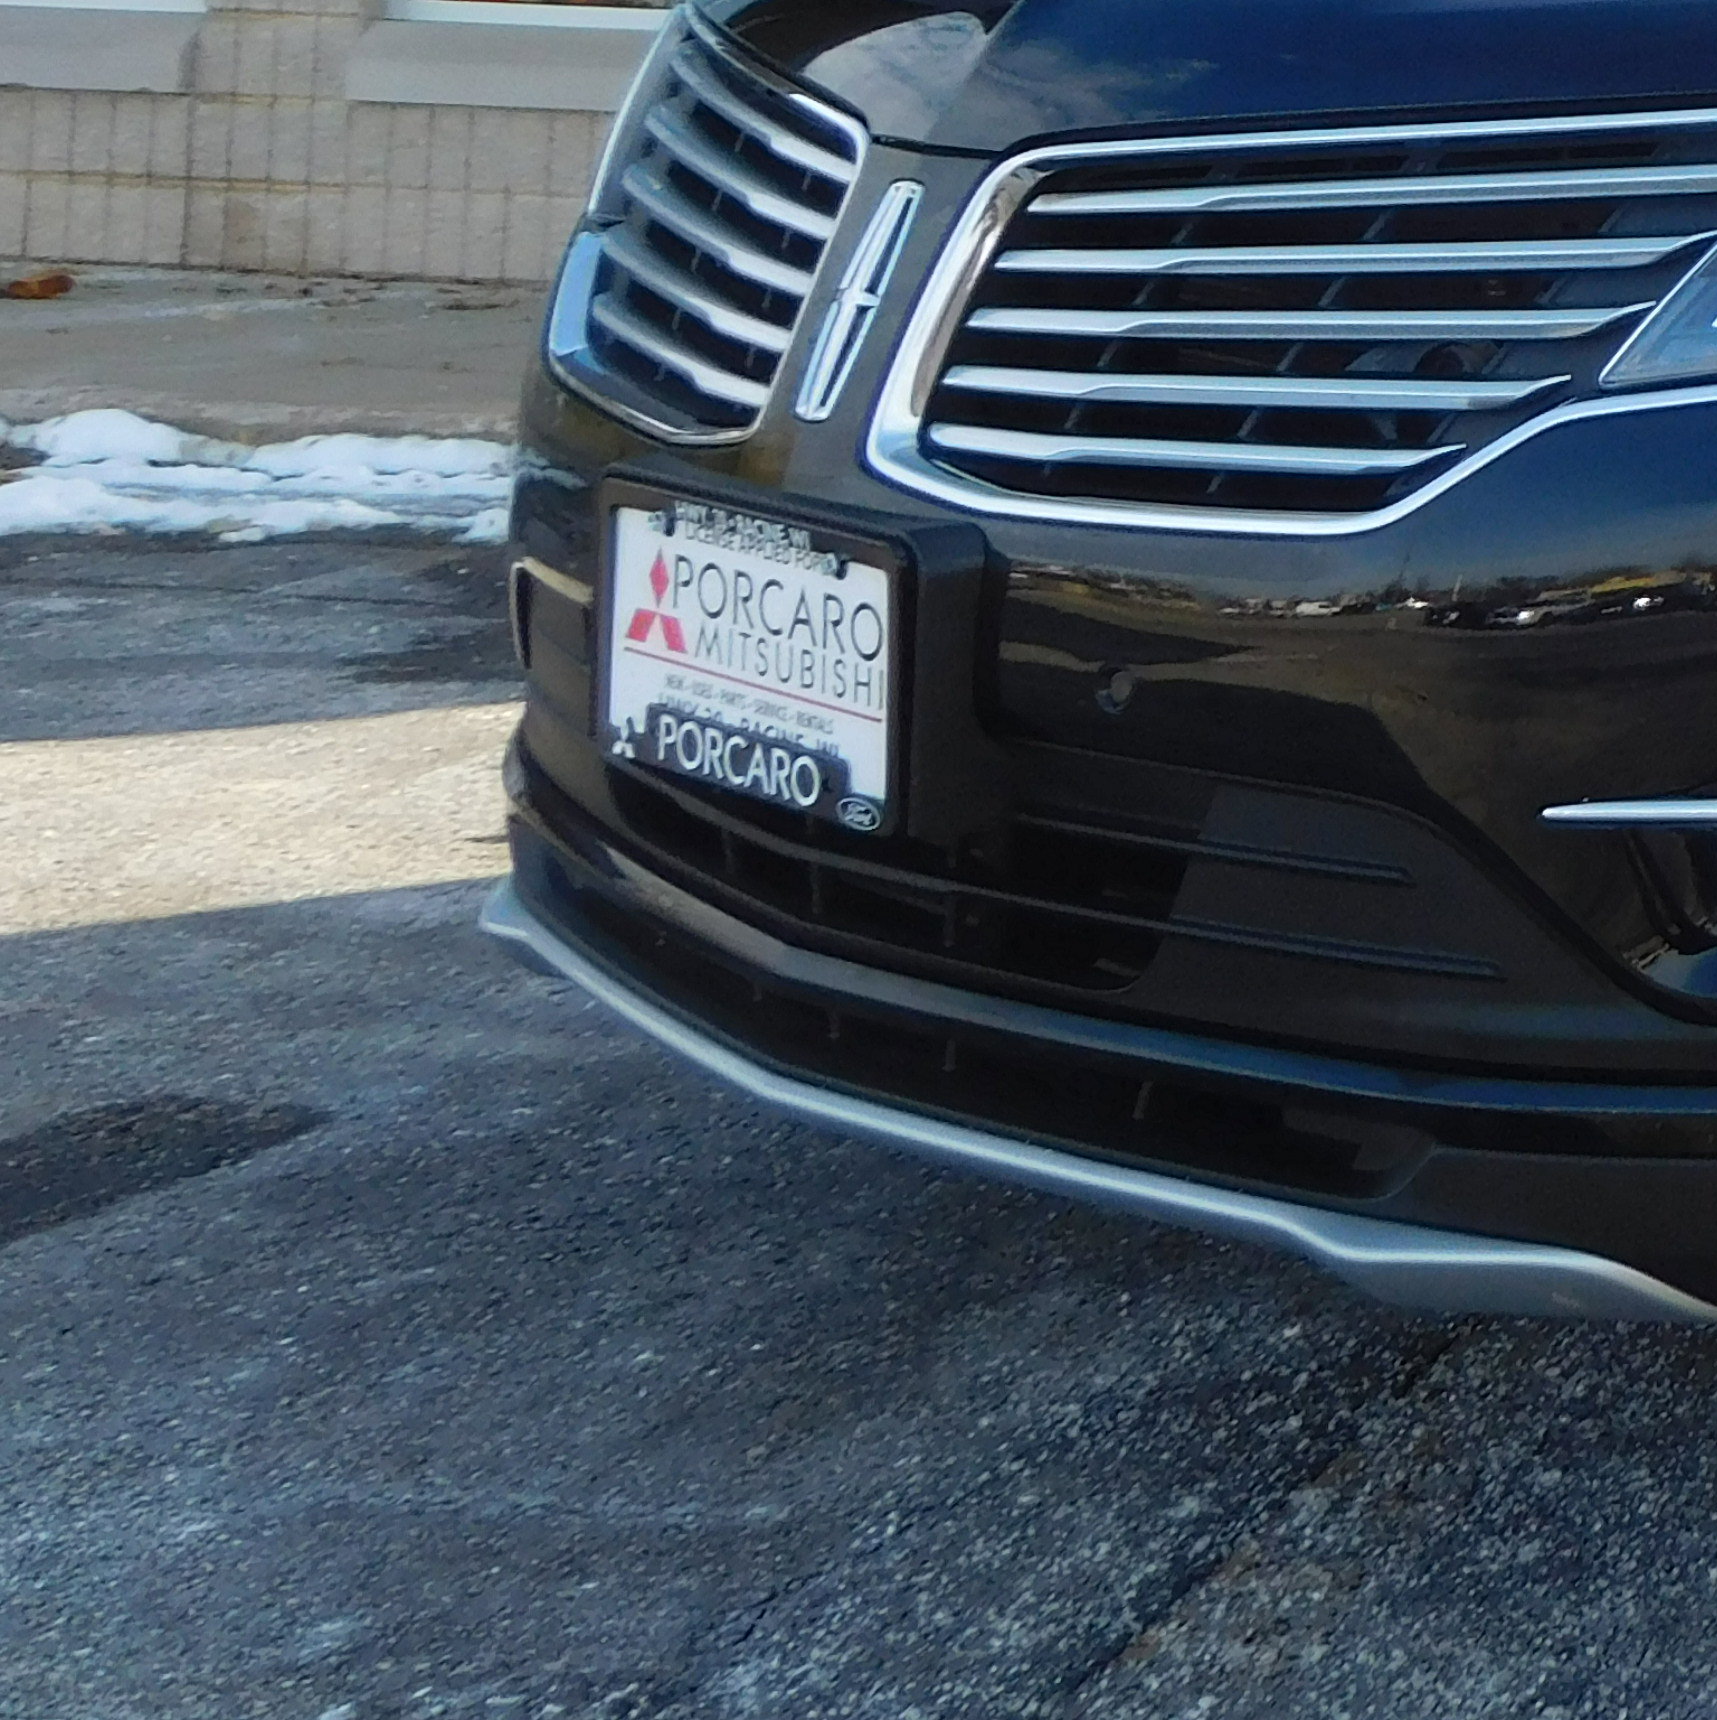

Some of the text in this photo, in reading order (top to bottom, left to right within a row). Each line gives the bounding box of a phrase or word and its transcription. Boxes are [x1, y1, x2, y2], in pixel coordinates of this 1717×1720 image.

[673, 555, 884, 661] PORCARO
[695, 621, 885, 710] MITSUBISHI
[658, 715, 820, 806] PORCARO
